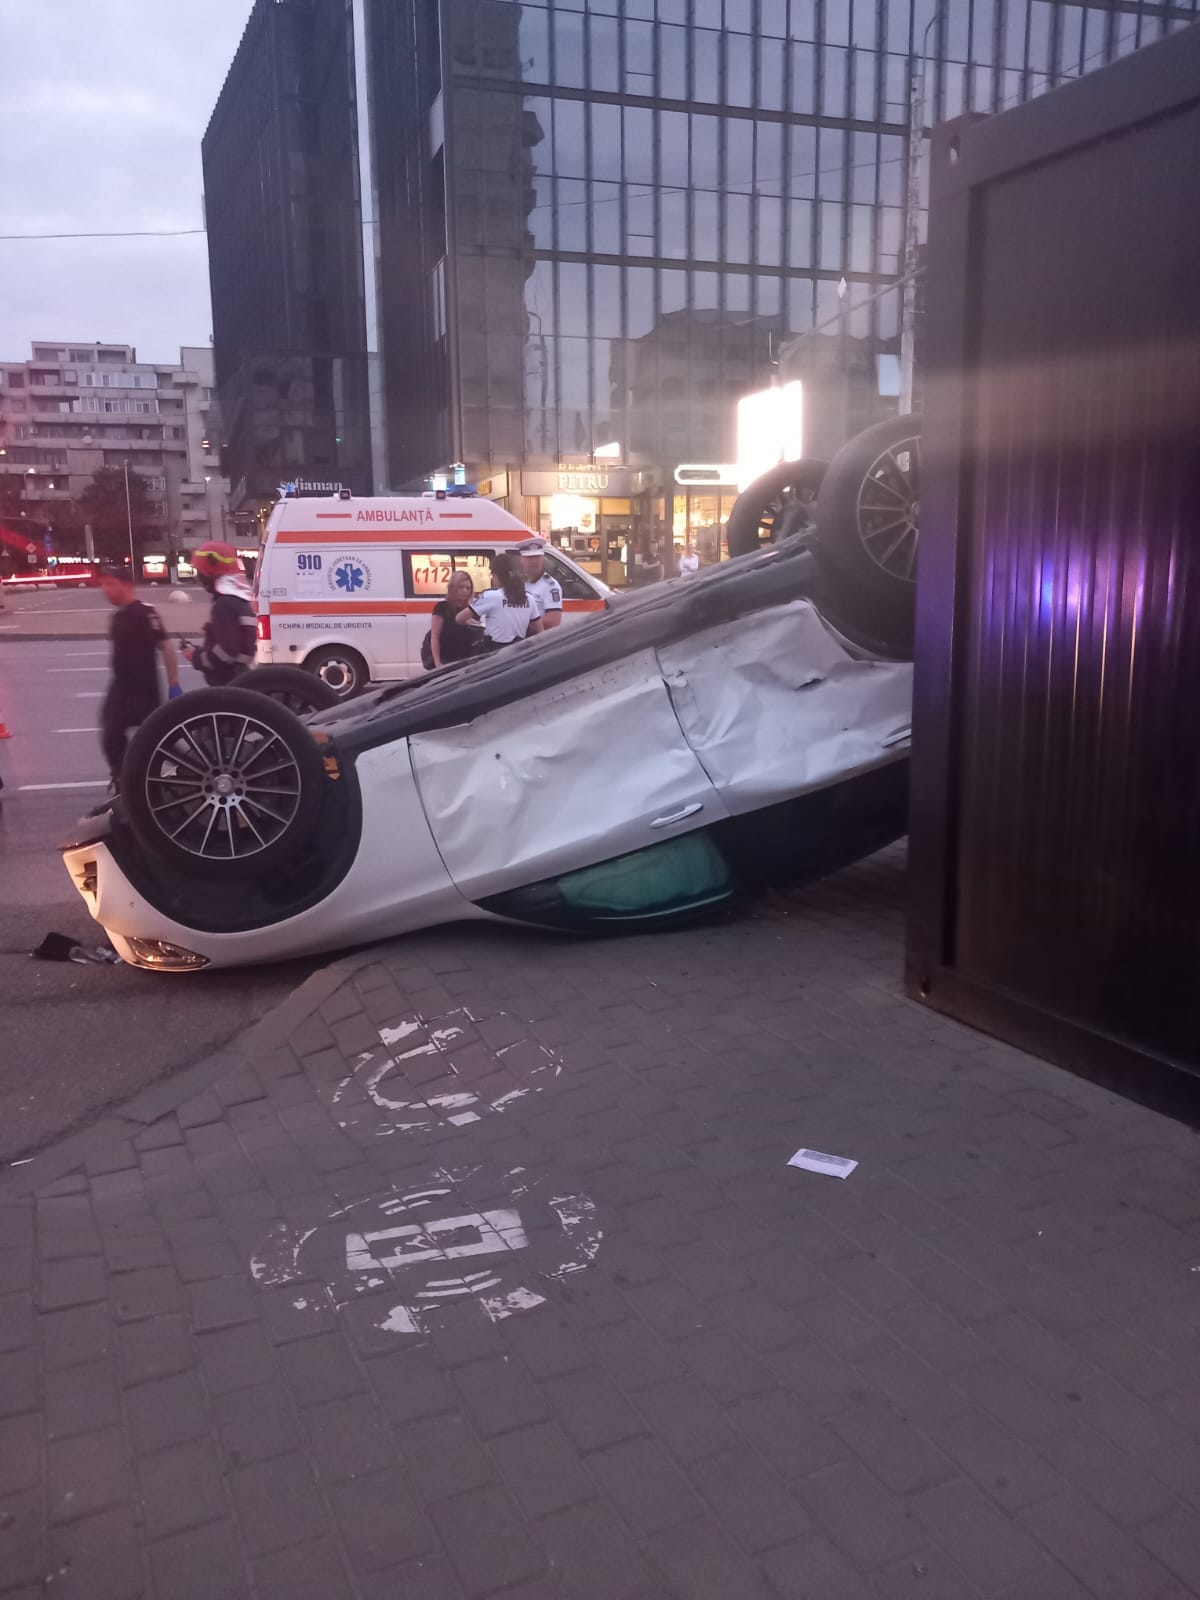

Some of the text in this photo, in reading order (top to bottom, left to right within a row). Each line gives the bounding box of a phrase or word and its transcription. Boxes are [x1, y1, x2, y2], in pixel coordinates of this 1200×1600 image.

[558, 474, 608, 489] PETRU
[297, 554, 321, 570] 910
[423, 567, 450, 584] 112
[333, 621, 341, 629] DE
